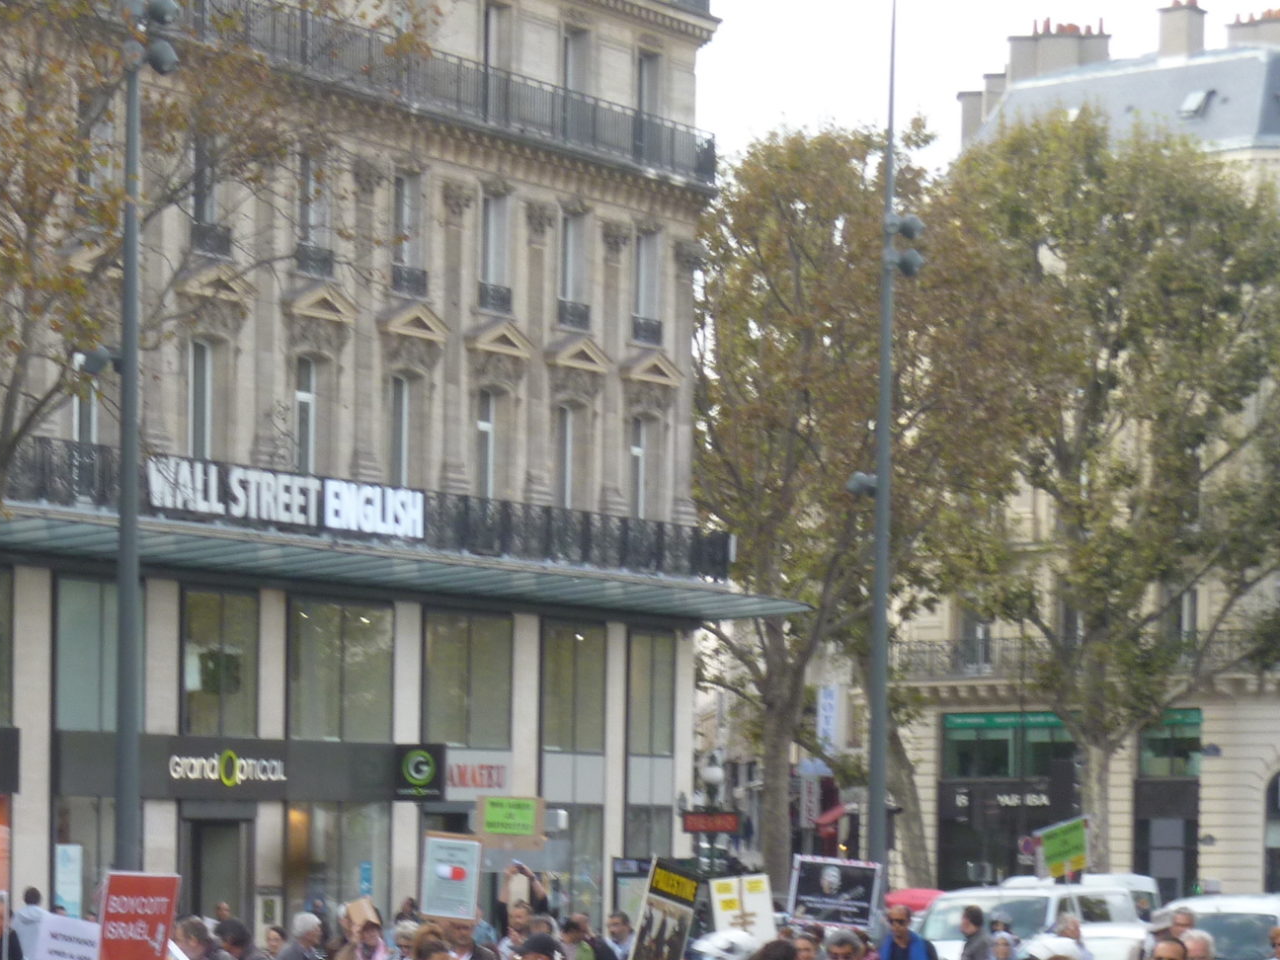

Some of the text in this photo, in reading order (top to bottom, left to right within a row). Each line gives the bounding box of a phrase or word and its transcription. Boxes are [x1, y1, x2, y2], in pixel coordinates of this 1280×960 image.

[147, 454, 425, 539] WALL STREET ENGLISH
